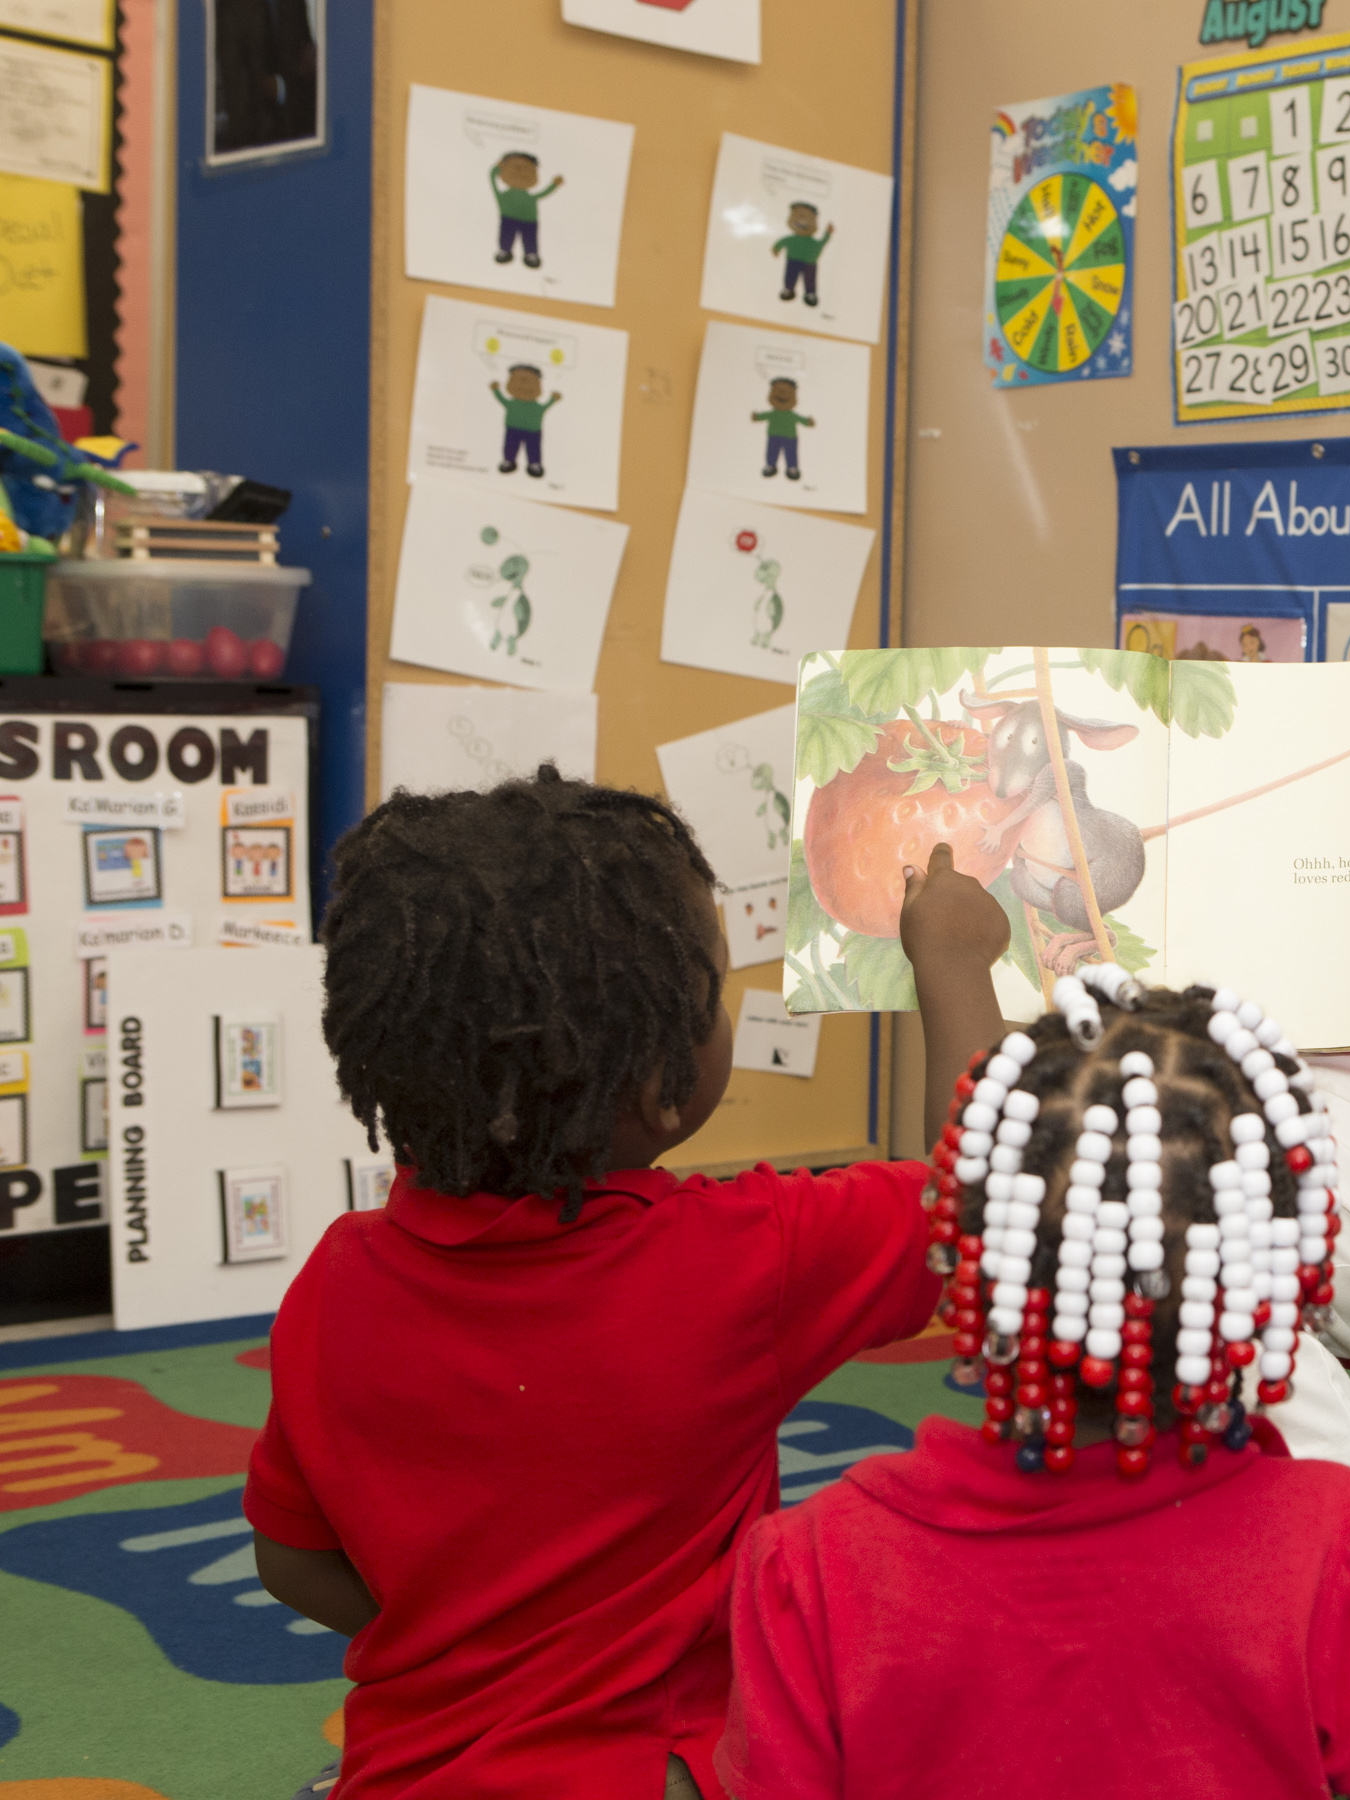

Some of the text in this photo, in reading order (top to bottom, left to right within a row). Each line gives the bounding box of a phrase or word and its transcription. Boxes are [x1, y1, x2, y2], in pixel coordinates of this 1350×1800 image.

[1284, 97, 1297, 137] 1
[1191, 174, 1208, 214] 6
[1242, 166, 1260, 208] 7
[1283, 165, 1300, 206] 8
[1328, 156, 1346, 196] 9
[1188, 246, 1219, 291] 13
[1228, 232, 1260, 278] 14
[1279, 219, 1309, 265] 15
[1178, 294, 1217, 344] 20
[1224, 284, 1263, 331] 21
[1271, 284, 1309, 329] 22
[1185, 352, 1221, 393] 27
[1268, 344, 1310, 393] 29
[1165, 481, 1231, 537] All
[1293, 856, 1335, 870] Ohhh,
[1293, 872, 1328, 884] loves
[120, 1016, 144, 1108] BOARD
[123, 1124, 149, 1264] PLANNING
